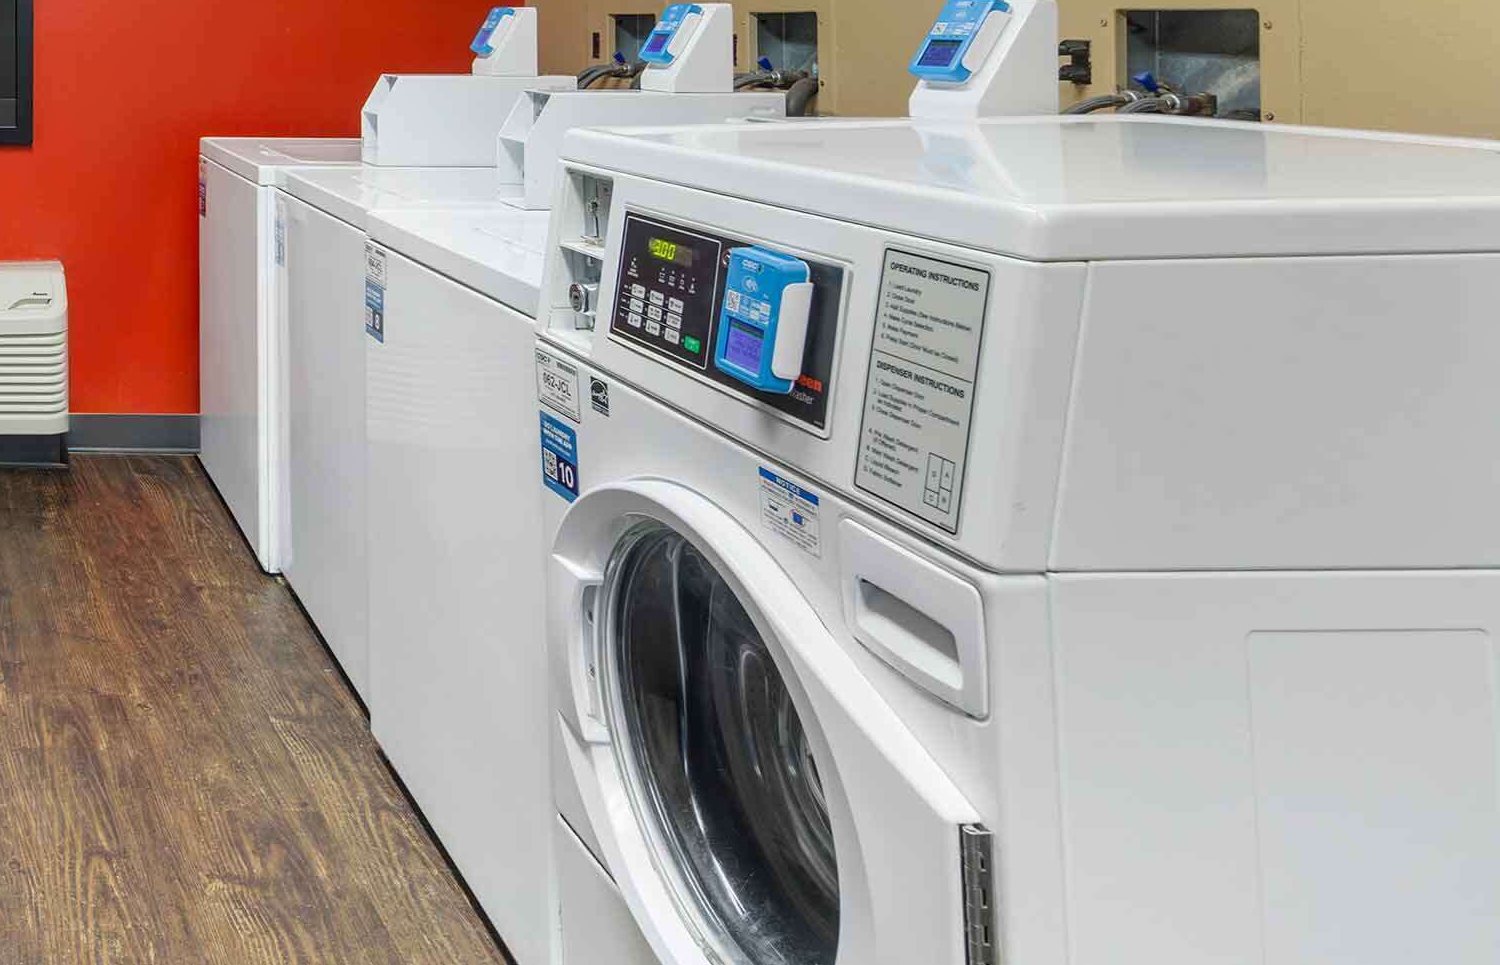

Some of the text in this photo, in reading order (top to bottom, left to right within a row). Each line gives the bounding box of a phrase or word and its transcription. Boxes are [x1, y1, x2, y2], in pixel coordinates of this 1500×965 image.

[890, 262, 979, 291] OPERATING INSTRUCTIONS
[876, 360, 964, 399] DISPENSER INSTRUCTIONS
[559, 462, 574, 489] 10
